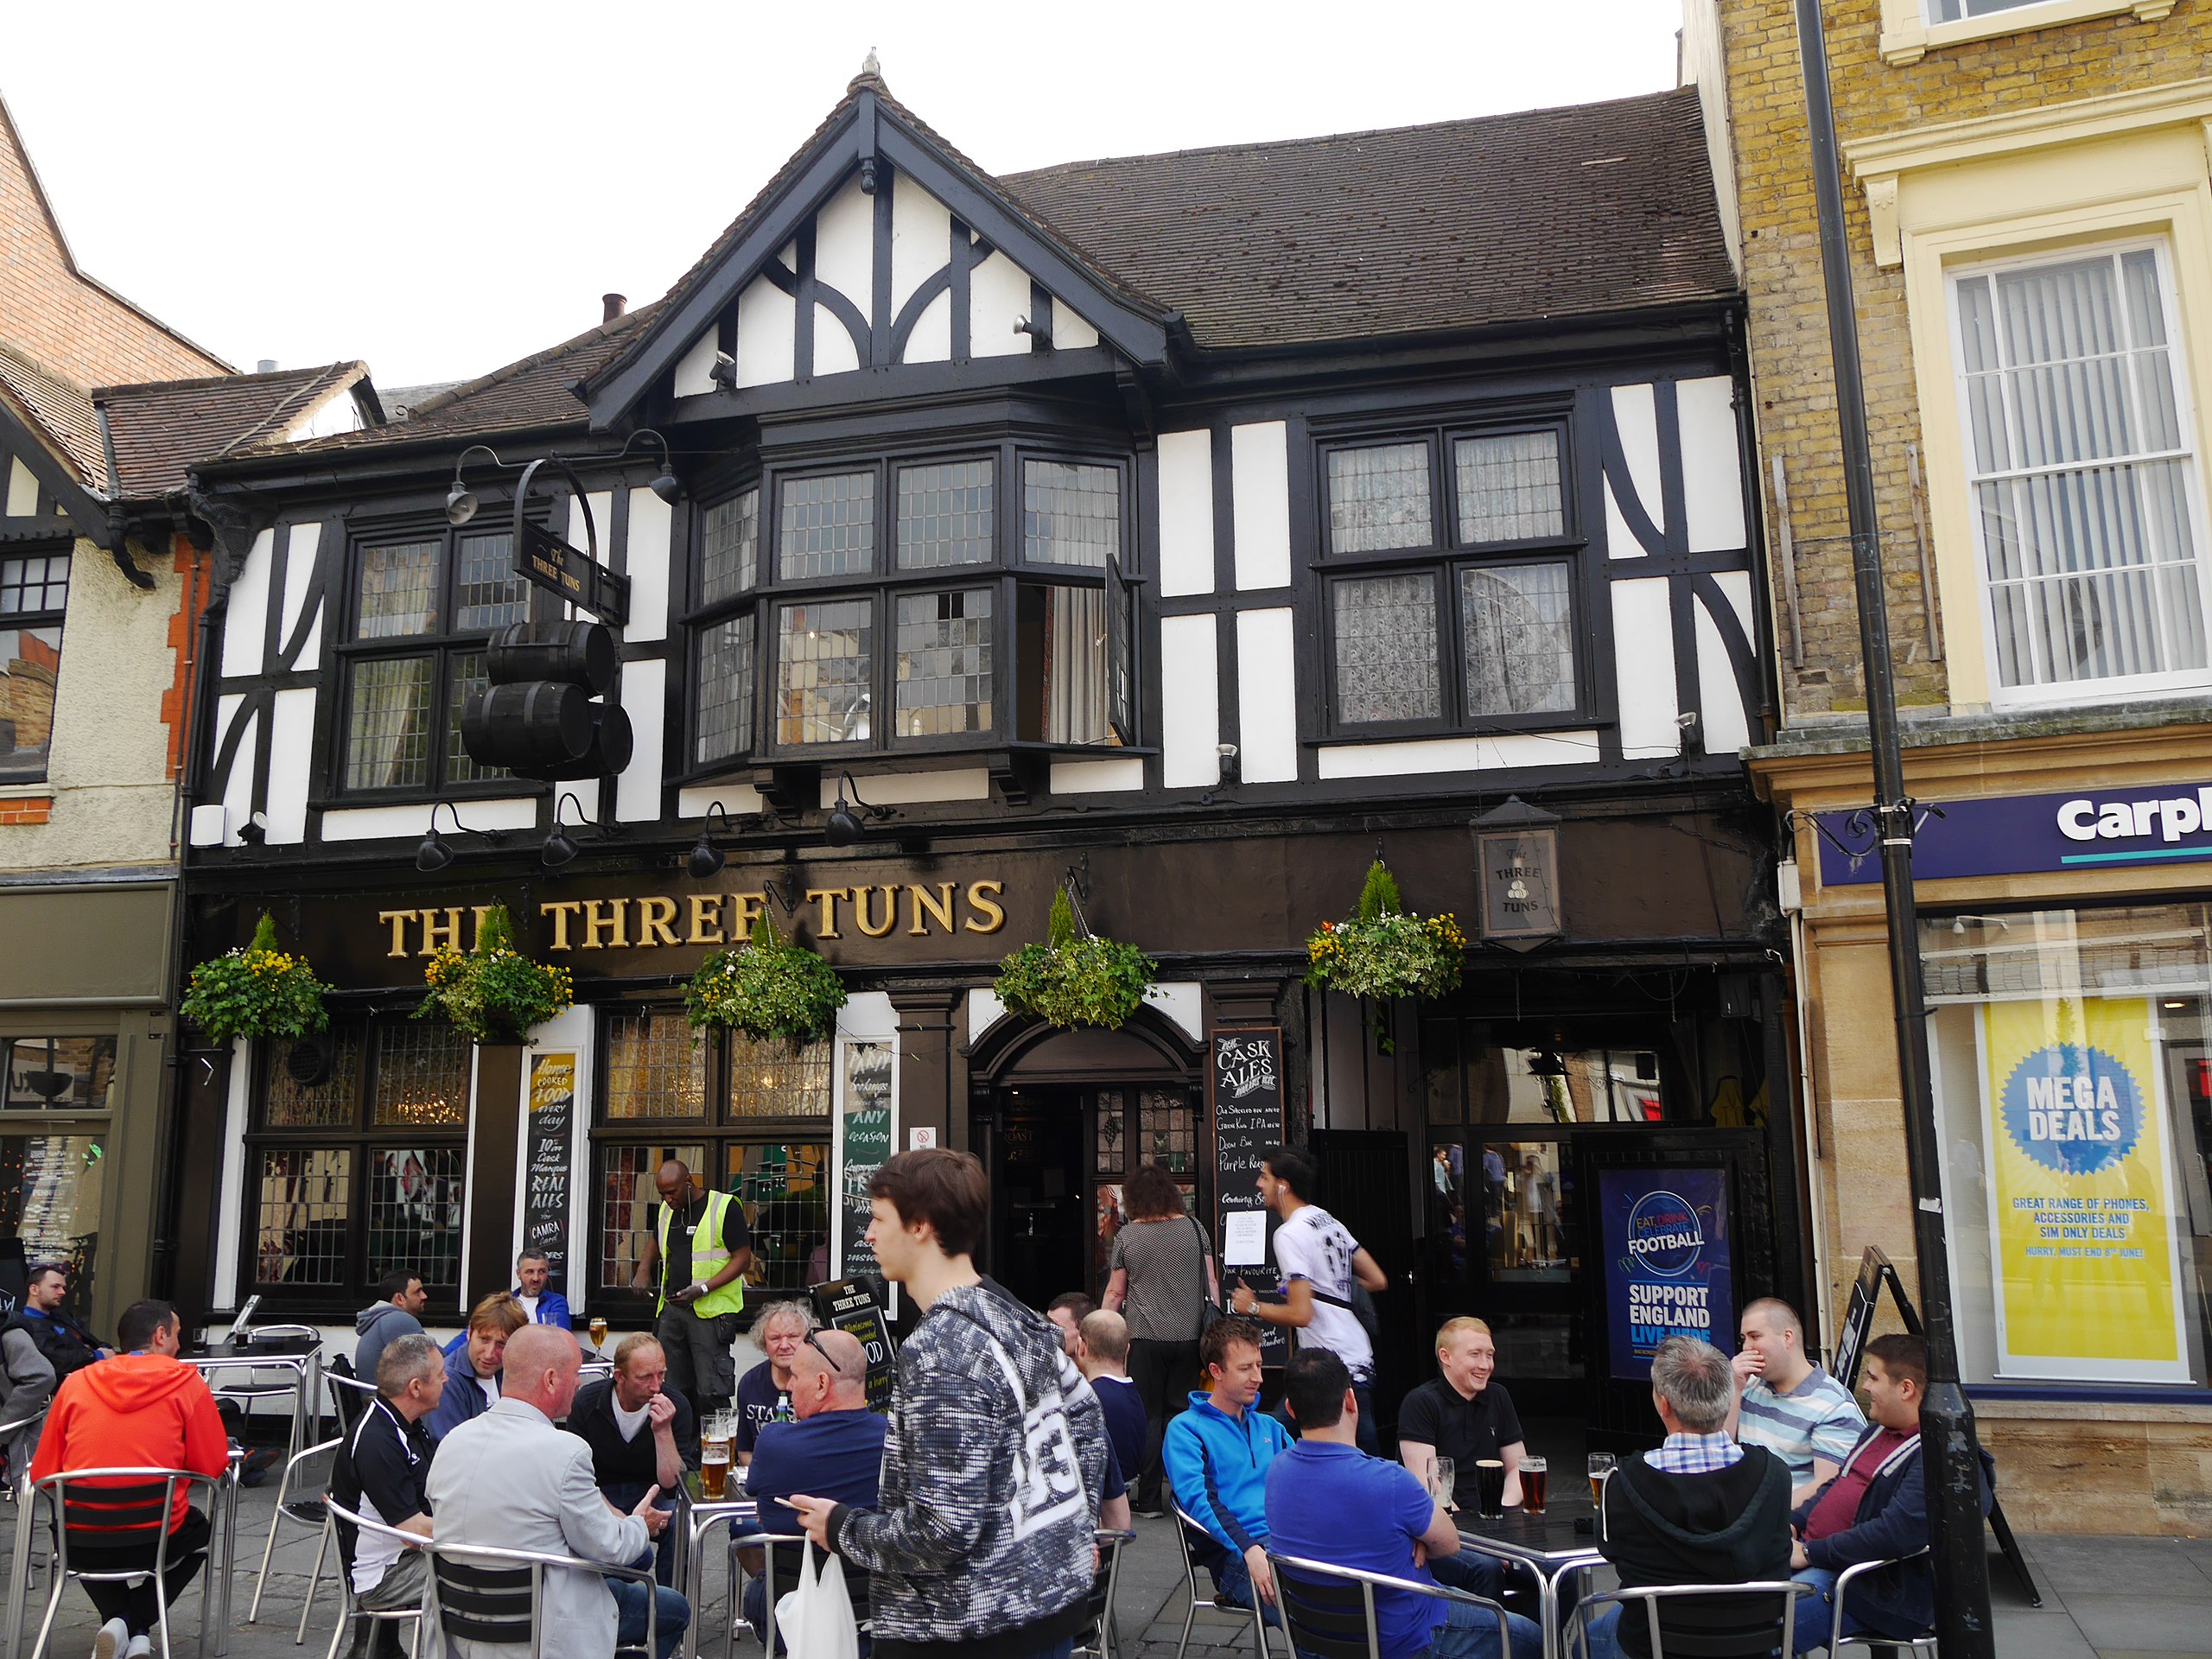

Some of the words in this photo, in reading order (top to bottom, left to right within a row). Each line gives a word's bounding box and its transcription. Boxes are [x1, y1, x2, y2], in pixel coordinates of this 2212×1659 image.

[550, 548, 563, 566] The
[532, 555, 558, 582] THREE
[561, 571, 580, 593] TUNS
[1506, 845, 1527, 860] The
[1496, 867, 1541, 880] THREE
[806, 880, 1004, 939] TUNS
[1503, 900, 1539, 912] TUNS
[1217, 1040, 1273, 1071] CASK
[537, 1058, 571, 1075] Home
[1220, 1058, 1273, 1088] ALES
[537, 1076, 568, 1087] COOKED
[537, 1087, 570, 1103] FOOD
[2026, 1077, 2119, 1109] MEGA
[538, 1114, 565, 1132] day
[852, 1110, 887, 1124] ANY
[2029, 1110, 2121, 1141] DEALS
[849, 1131, 889, 1142] OCCASION
[537, 1152, 562, 1162] Cask
[1219, 1152, 1247, 1172] Purple
[1249, 1154, 1265, 1172] Reig
[531, 1175, 564, 1192] REAL
[531, 1193, 564, 1209] ALES
[1222, 1192, 1253, 1208] Coming
[2012, 1198, 2045, 1209] GREAT
[2049, 1198, 2083, 1209] RANGE
[2087, 1198, 2100, 1209] OF
[2104, 1198, 2149, 1211] PHONES,
[2034, 1212, 2105, 1224] ACCESSORIES
[2108, 1213, 2129, 1224] AND
[531, 1221, 560, 1239] CAMRA
[2040, 1227, 2059, 1237] SIM
[2063, 1228, 2088, 1238] ONLY
[2092, 1228, 2126, 1238] DEALS
[1628, 1230, 1705, 1254] FOOTBALL
[2026, 1247, 2056, 1257] HURRY,
[2059, 1247, 2082, 1256] MUST
[2085, 1248, 2102, 1256] END
[2120, 1249, 2144, 1257] JUNE!
[843, 1284, 855, 1295] THE
[1629, 1285, 1708, 1307] SUPPORT
[832, 1299, 855, 1312] THREE
[854, 1293, 871, 1307] TUNS
[1630, 1305, 1710, 1328] ENGLAND
[1630, 1325, 1665, 1344] LIVE
